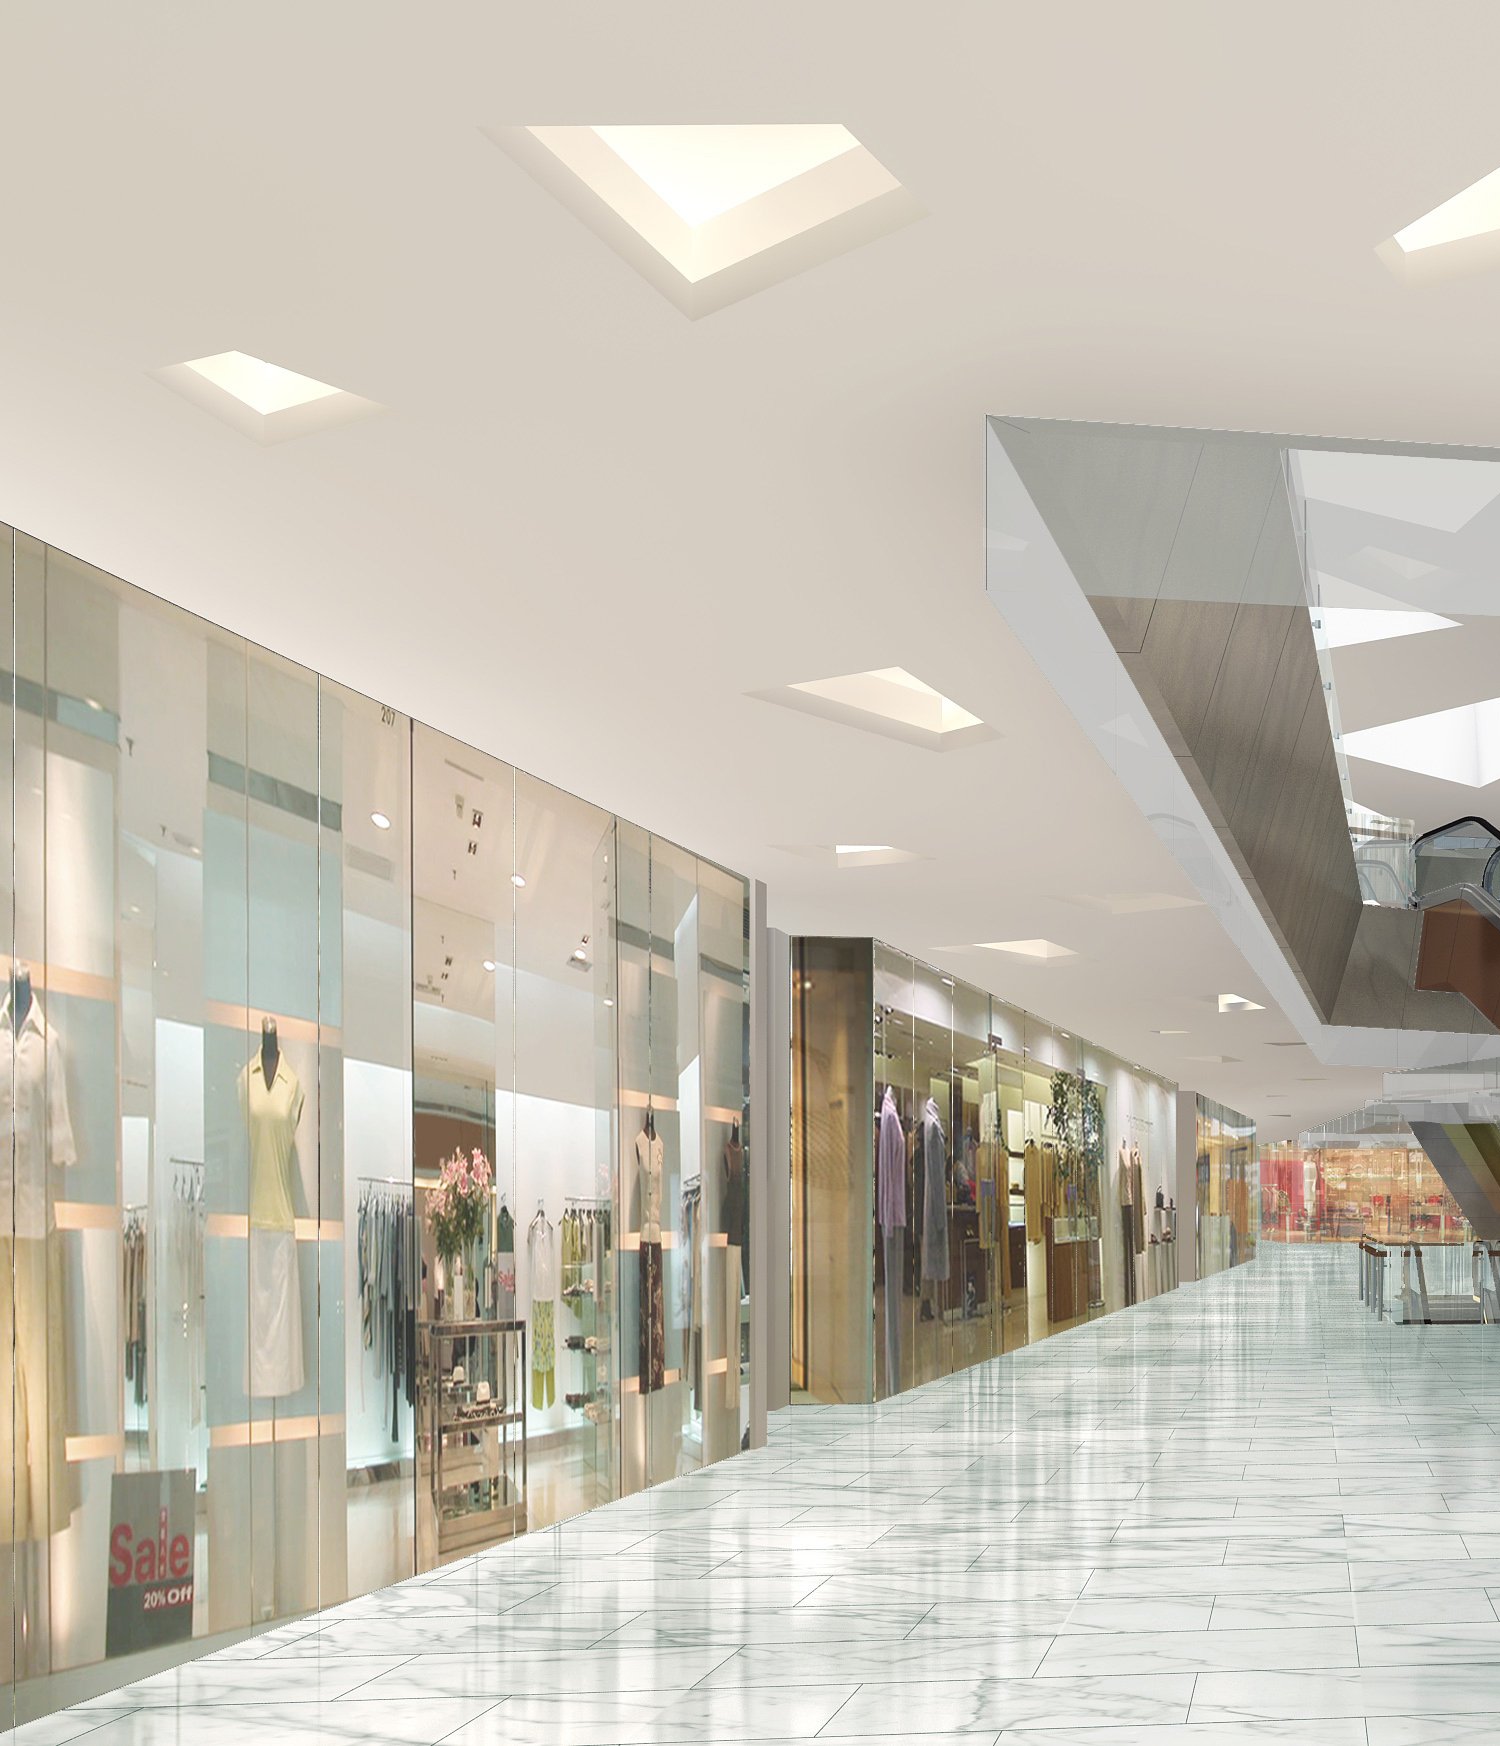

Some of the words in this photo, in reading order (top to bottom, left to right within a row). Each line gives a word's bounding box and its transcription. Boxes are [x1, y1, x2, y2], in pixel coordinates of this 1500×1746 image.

[381, 705, 396, 726] 207
[110, 1506, 190, 1588] Sale
[143, 1588, 166, 1609] 20%
[167, 1584, 193, 1604] Off
